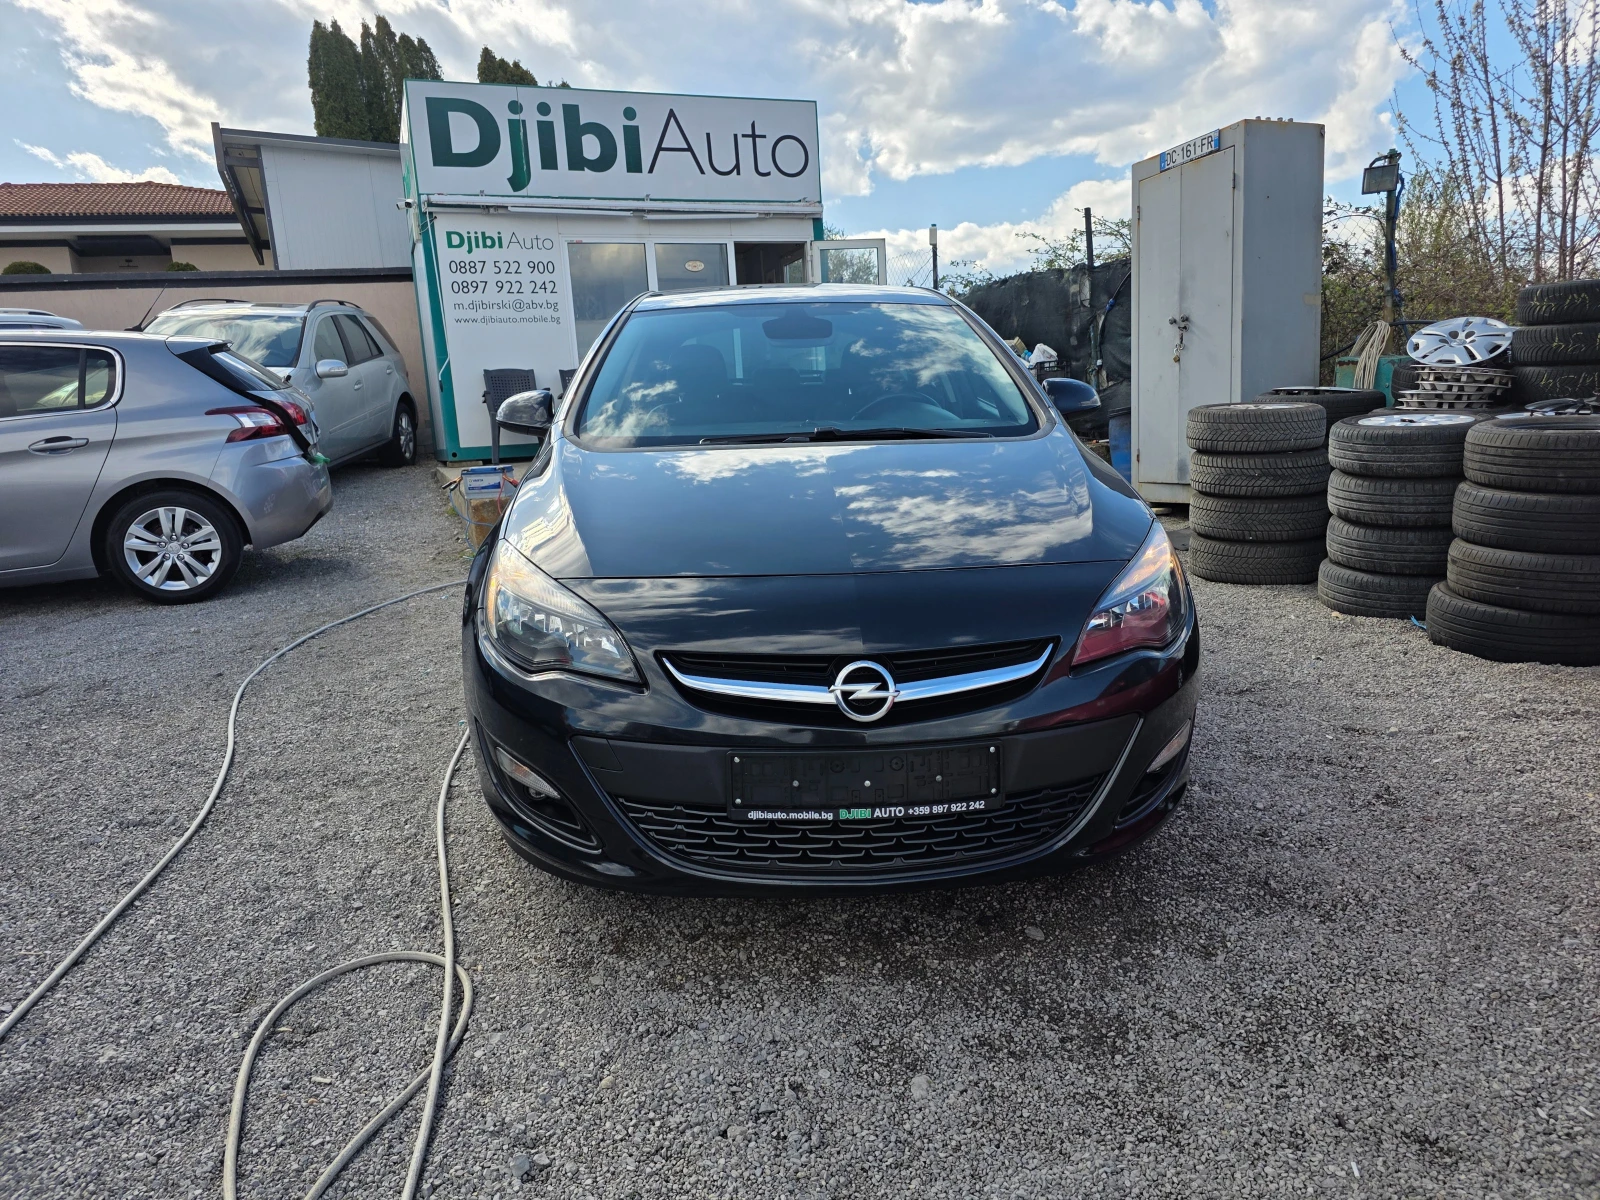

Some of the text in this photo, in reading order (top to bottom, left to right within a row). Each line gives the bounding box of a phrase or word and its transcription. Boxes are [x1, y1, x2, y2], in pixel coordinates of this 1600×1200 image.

[445, 230, 554, 255] Djibi Auto
[448, 260, 556, 275] 0887 522 900
[451, 280, 558, 294] 0897 922 242
[453, 298, 560, 313] m.djibirski@abv.bg
[454, 315, 562, 326] www.djibiauto.mobile.bg
[747, 800, 986, 820] djibiauto.mobile.bg DJIBI AUTO +359 897 922 242
